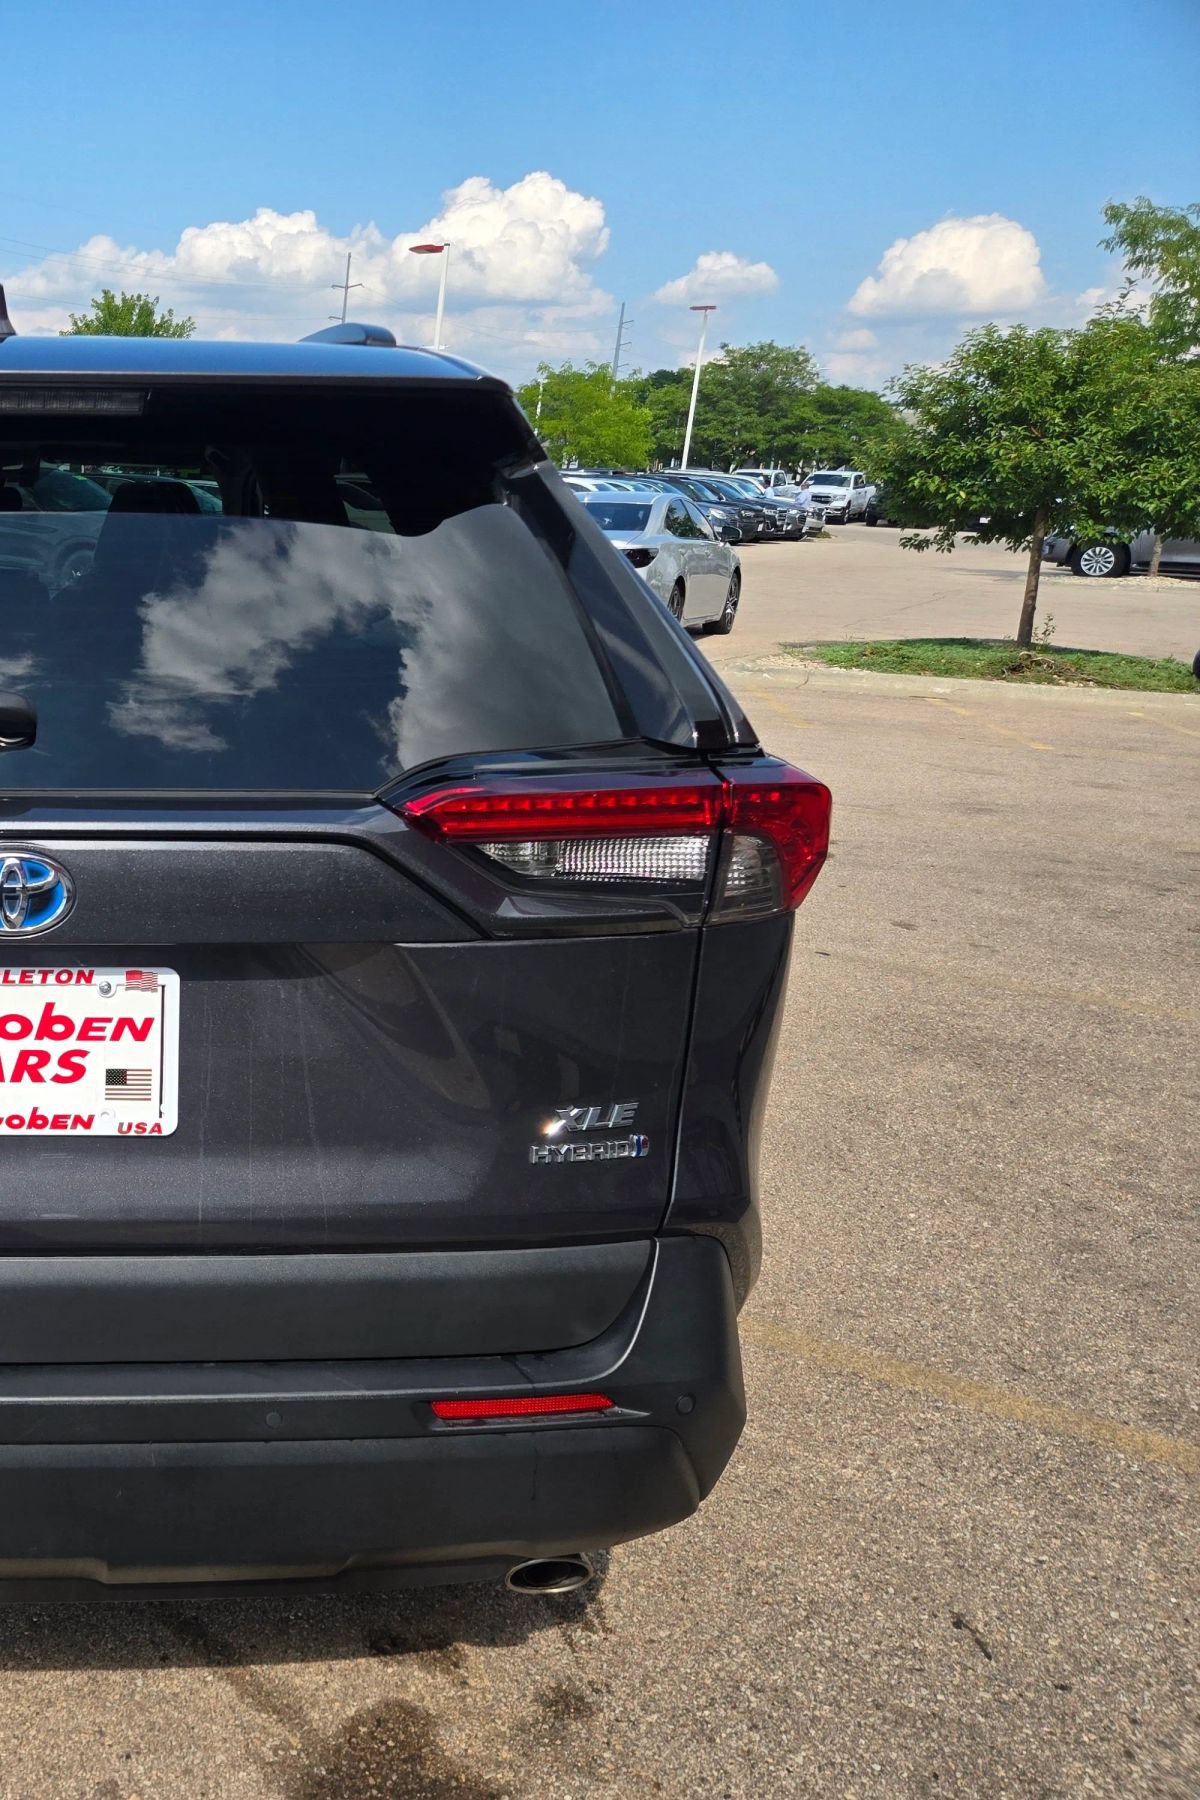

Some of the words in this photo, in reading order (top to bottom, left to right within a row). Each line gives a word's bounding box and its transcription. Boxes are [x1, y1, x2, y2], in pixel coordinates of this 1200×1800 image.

[118, 1122, 163, 1135] USA
[544, 1101, 640, 1135] XLE
[530, 1140, 631, 1165] HYBRID
